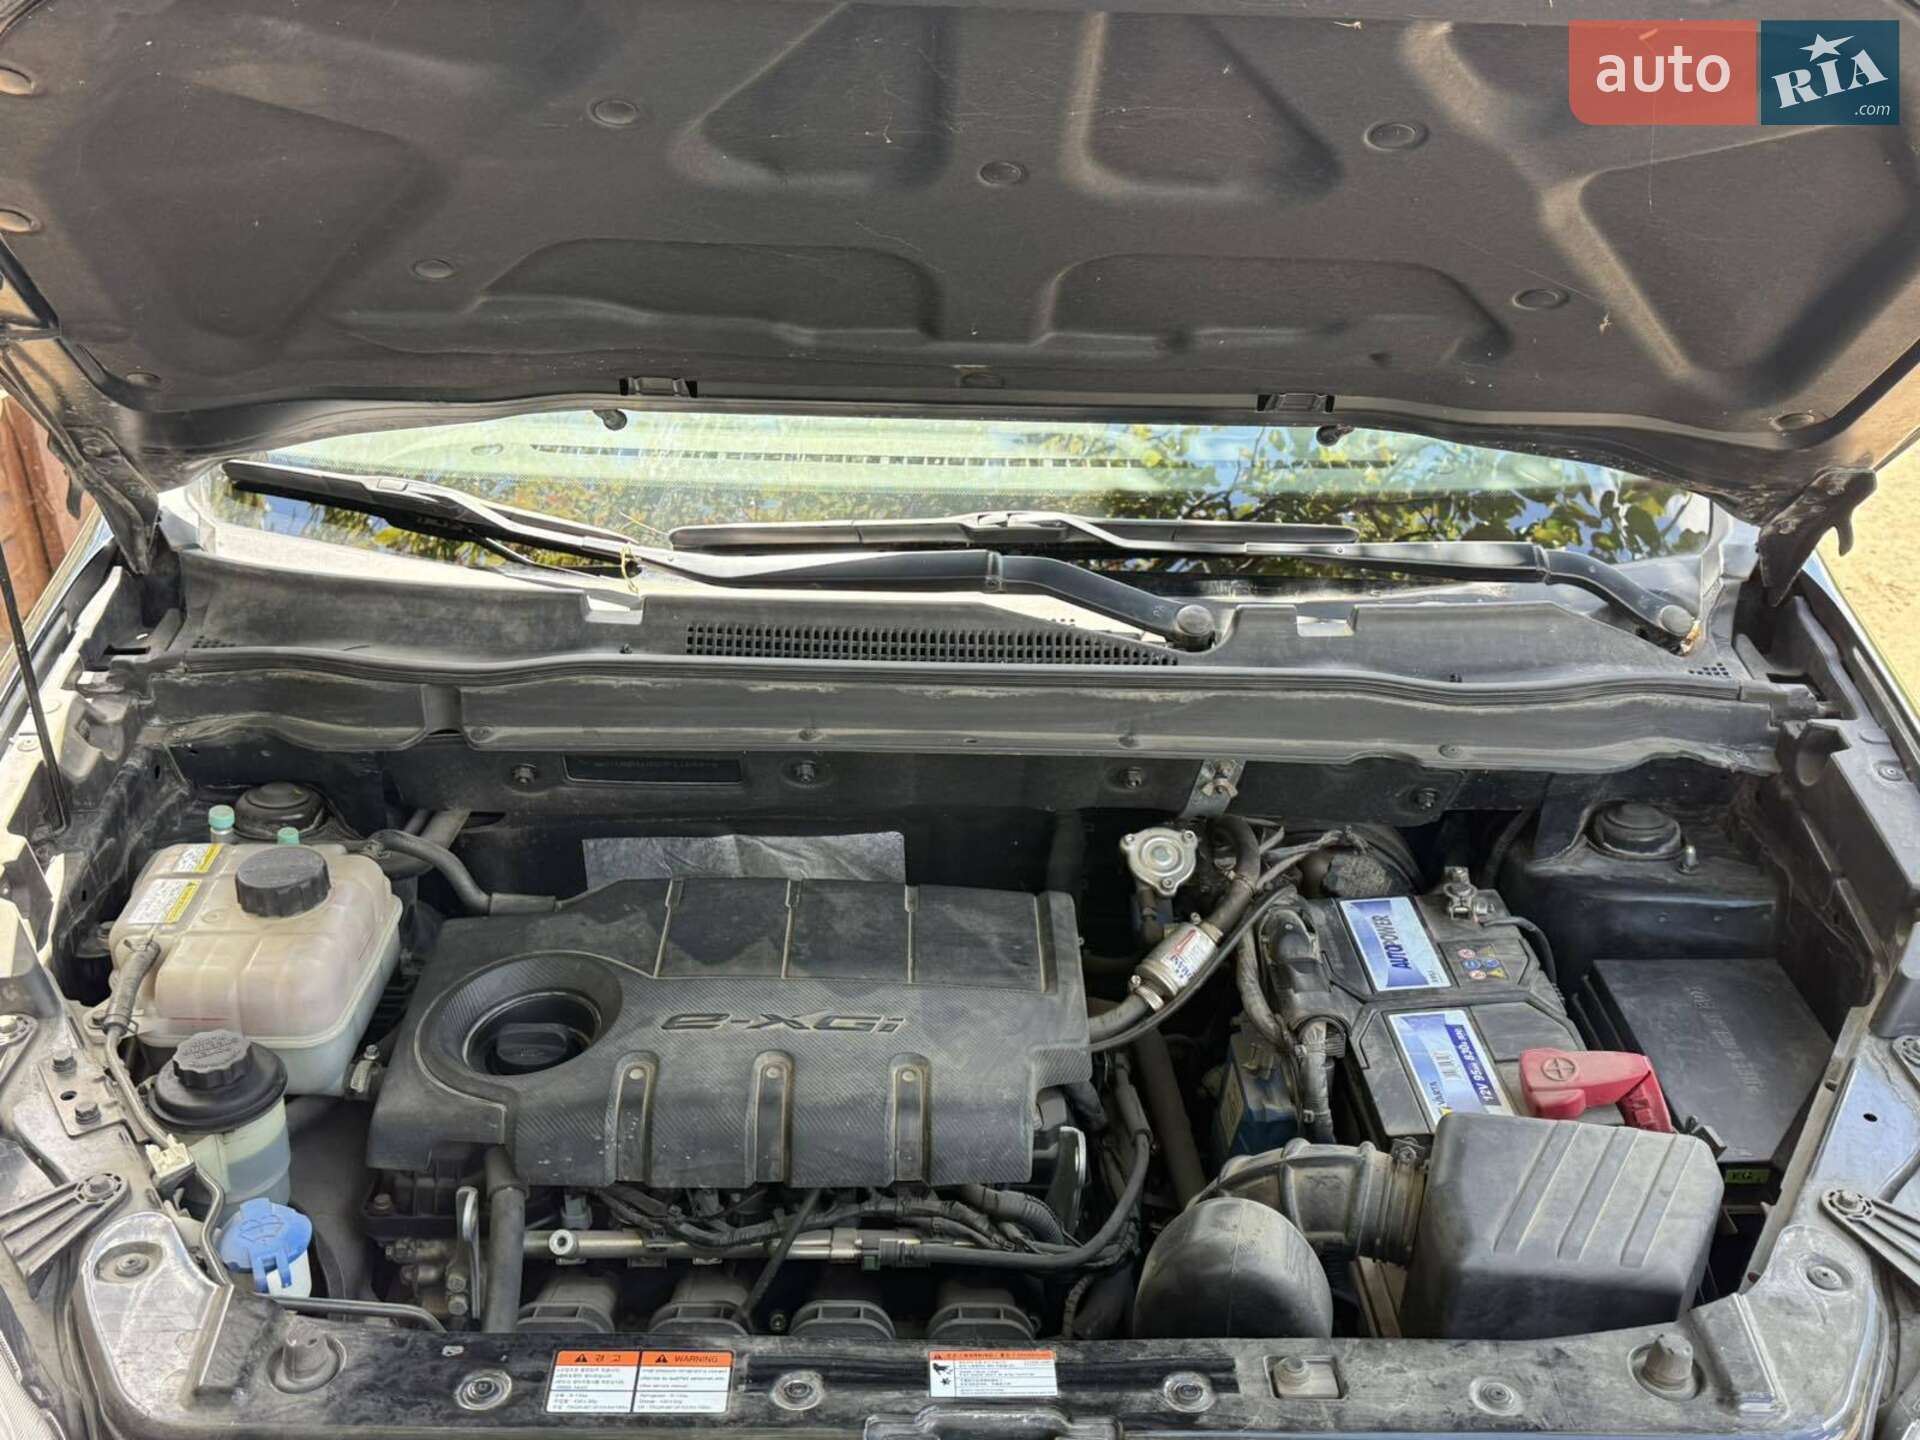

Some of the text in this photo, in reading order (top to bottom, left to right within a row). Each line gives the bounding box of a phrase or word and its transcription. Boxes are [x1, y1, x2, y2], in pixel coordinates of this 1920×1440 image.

[1372, 915, 1413, 970] AUTOPOWER
[1429, 1081, 1446, 1105] VARTA
[1476, 1082, 1494, 1102] 12V
[674, 1354, 719, 1363] WARNING
